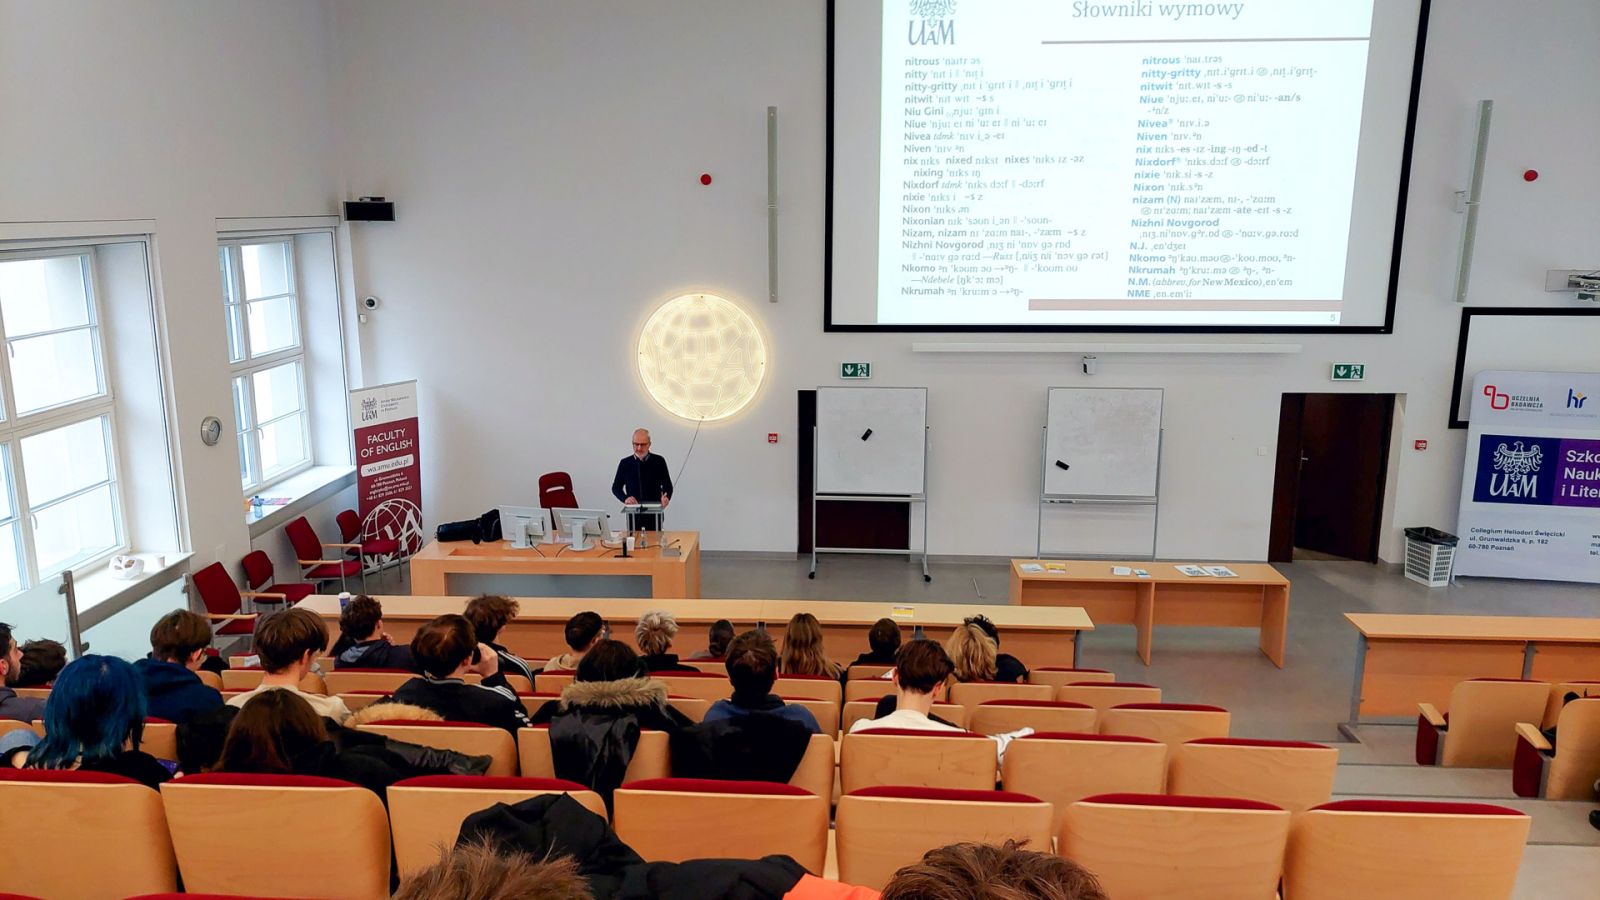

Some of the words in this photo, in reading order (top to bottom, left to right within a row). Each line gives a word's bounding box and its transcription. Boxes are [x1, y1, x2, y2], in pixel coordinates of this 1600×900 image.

[1072, 0, 1152, 18] Słowniki
[1158, 3, 1244, 20] wymowy
[905, 56, 939, 66] nitrous
[1142, 56, 1180, 65] nitrous
[905, 70, 927, 81] nitty
[1141, 68, 1200, 80] nitty-gritty
[905, 82, 957, 93] nitty-gritty
[1140, 81, 1172, 91] nitwit
[904, 94, 932, 104] nitwit
[1139, 94, 1163, 104] Niue
[904, 107, 920, 116] Niu
[924, 106, 944, 116] Gini
[904, 120, 926, 128] Niue
[904, 131, 930, 140] Nivea
[1137, 132, 1167, 142] Niven
[904, 144, 931, 153] Niven
[1136, 145, 1152, 154] nix
[946, 155, 972, 165] nixed
[1005, 155, 1029, 166] nixes
[914, 168, 943, 179] nixing
[1134, 170, 1160, 179] nixie
[903, 180, 939, 189] Nixdorf
[1133, 183, 1164, 192] Nixon
[903, 192, 925, 201] nixie
[1132, 195, 1164, 204] nizam
[903, 204, 930, 213] Nixon
[903, 216, 944, 225] Nixonian
[1131, 218, 1164, 227] Nizhni
[1167, 218, 1219, 229] Novgorod
[902, 228, 934, 239] Nizam,
[938, 228, 966, 238] nizam
[902, 240, 932, 249] Nizhni
[936, 240, 984, 252] Novgorod
[1130, 242, 1147, 250] N.J.
[1129, 254, 1165, 263] Nkomo
[902, 264, 935, 272] Nkomo
[1129, 266, 1175, 274] Nkrumah
[1128, 278, 1150, 286] N.M.
[902, 286, 944, 296] Nkrumah
[1127, 288, 1150, 298] NME
[368, 428, 406, 444] FACULTY
[361, 448, 374, 458] OF
[376, 438, 412, 454] ENGLISH
[1489, 473, 1538, 498] UAM
[1562, 484, 1566, 496] i
